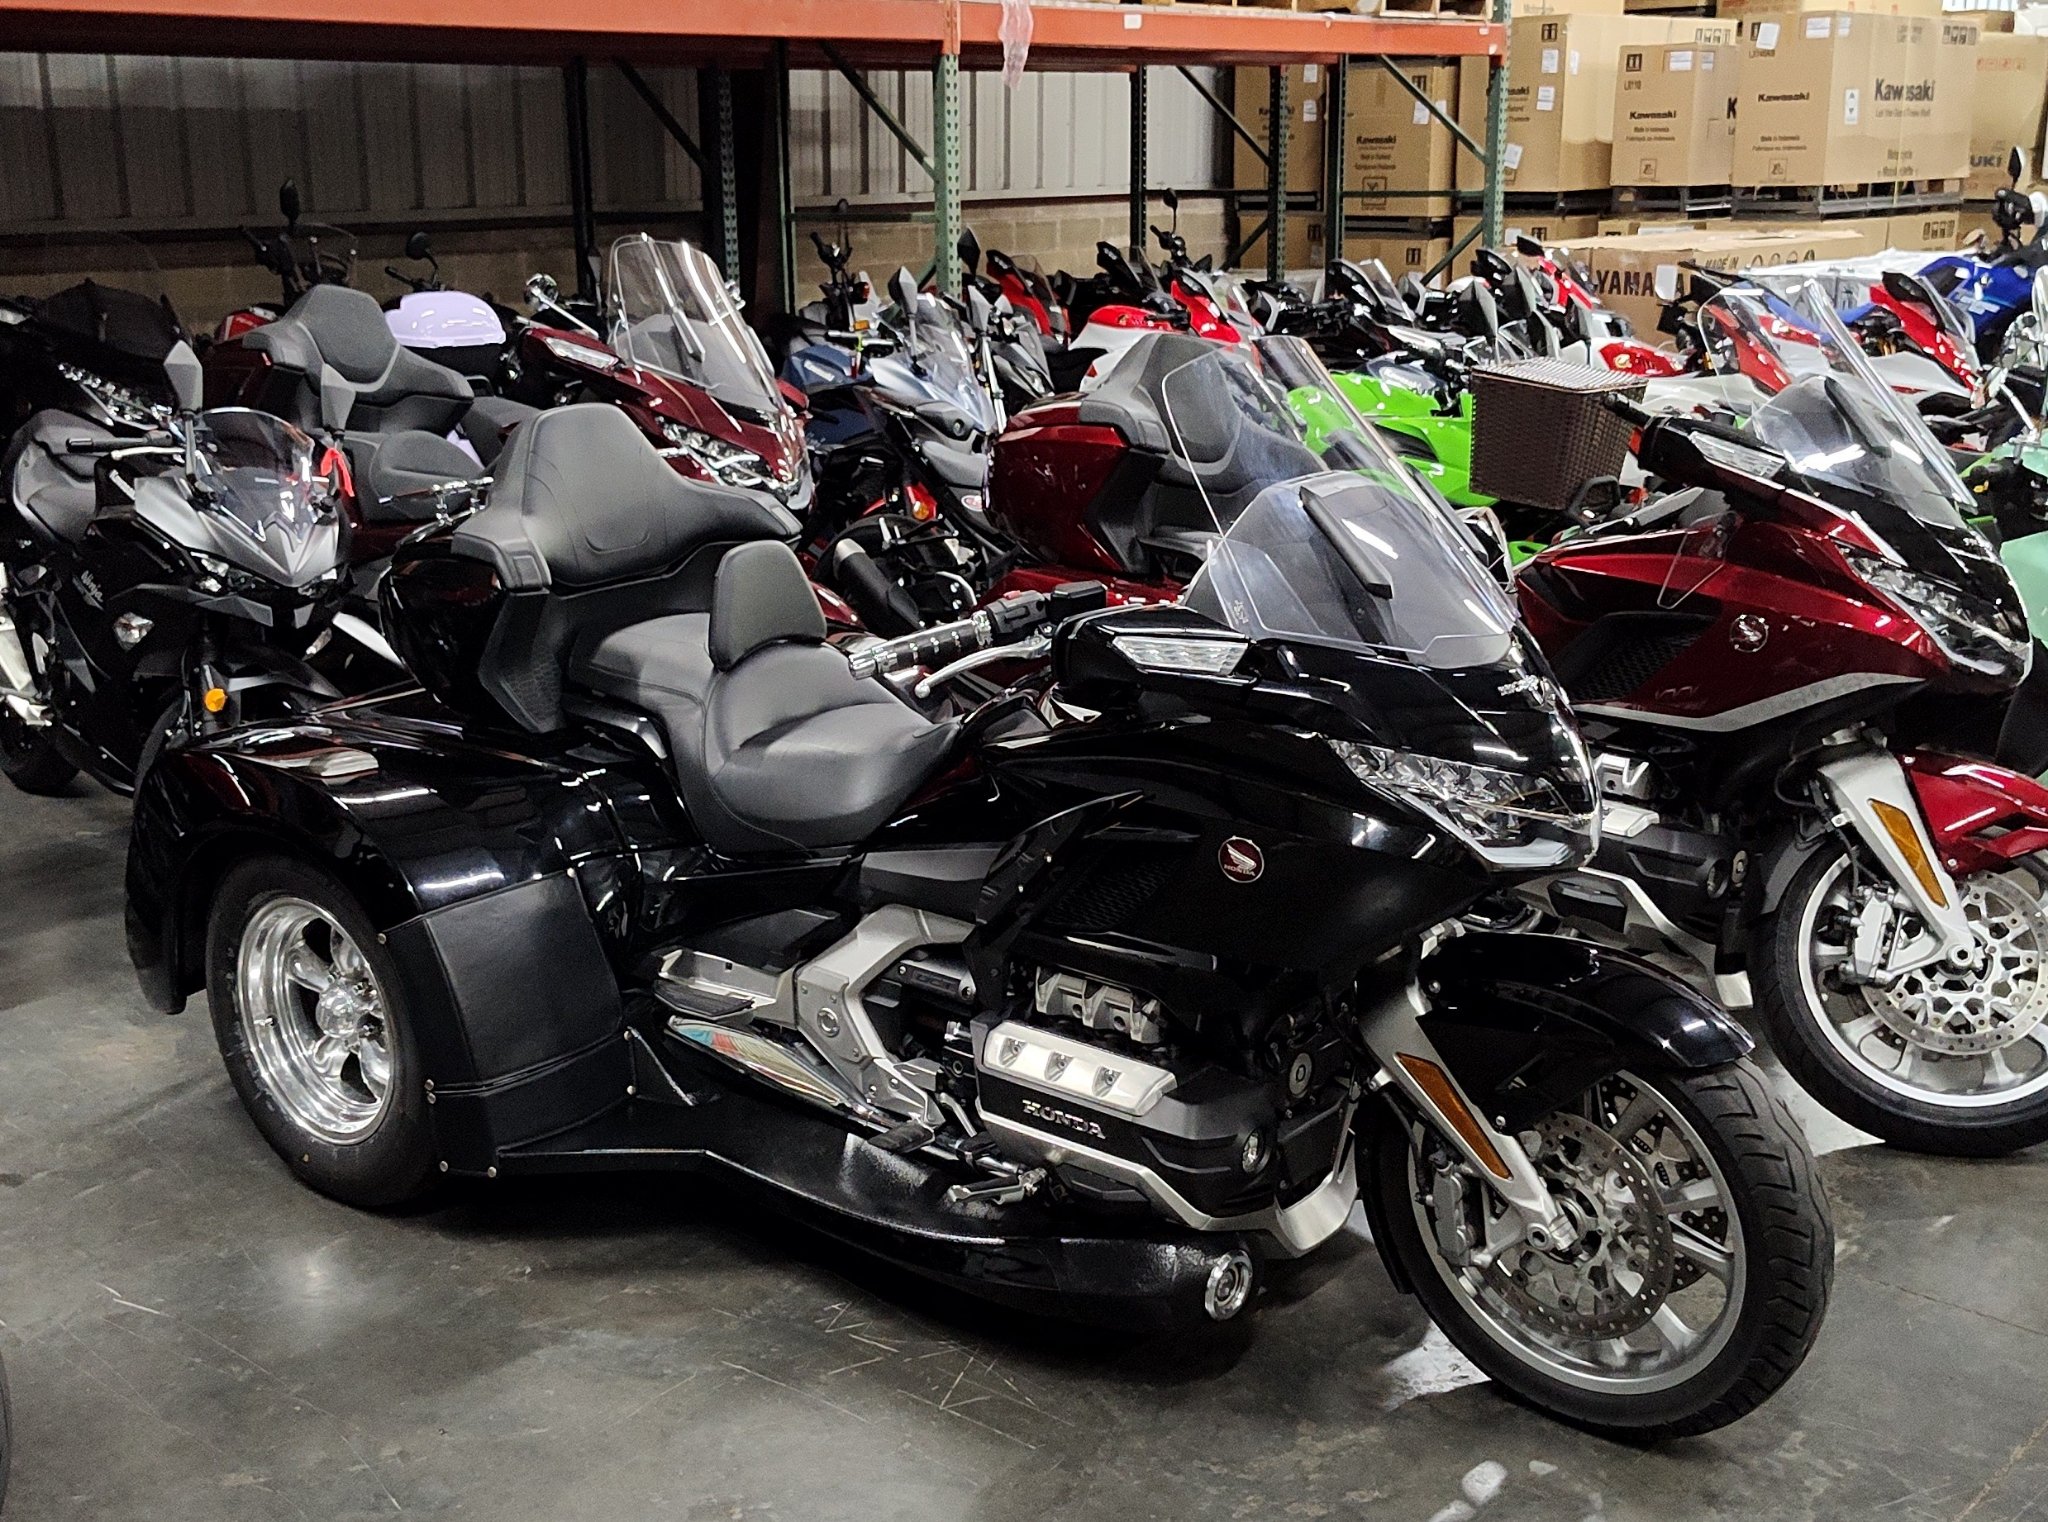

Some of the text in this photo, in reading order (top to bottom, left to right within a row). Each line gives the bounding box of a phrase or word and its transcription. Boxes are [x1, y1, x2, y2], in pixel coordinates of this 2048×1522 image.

[1757, 92, 1810, 102] Kawasaki
[1629, 110, 1677, 120] Kawasaki
[1596, 269, 1685, 298] YAMAA
[80, 569, 104, 603] Ninja
[1222, 863, 1256, 877] HONDA
[1022, 1099, 1106, 1140] HONDA
